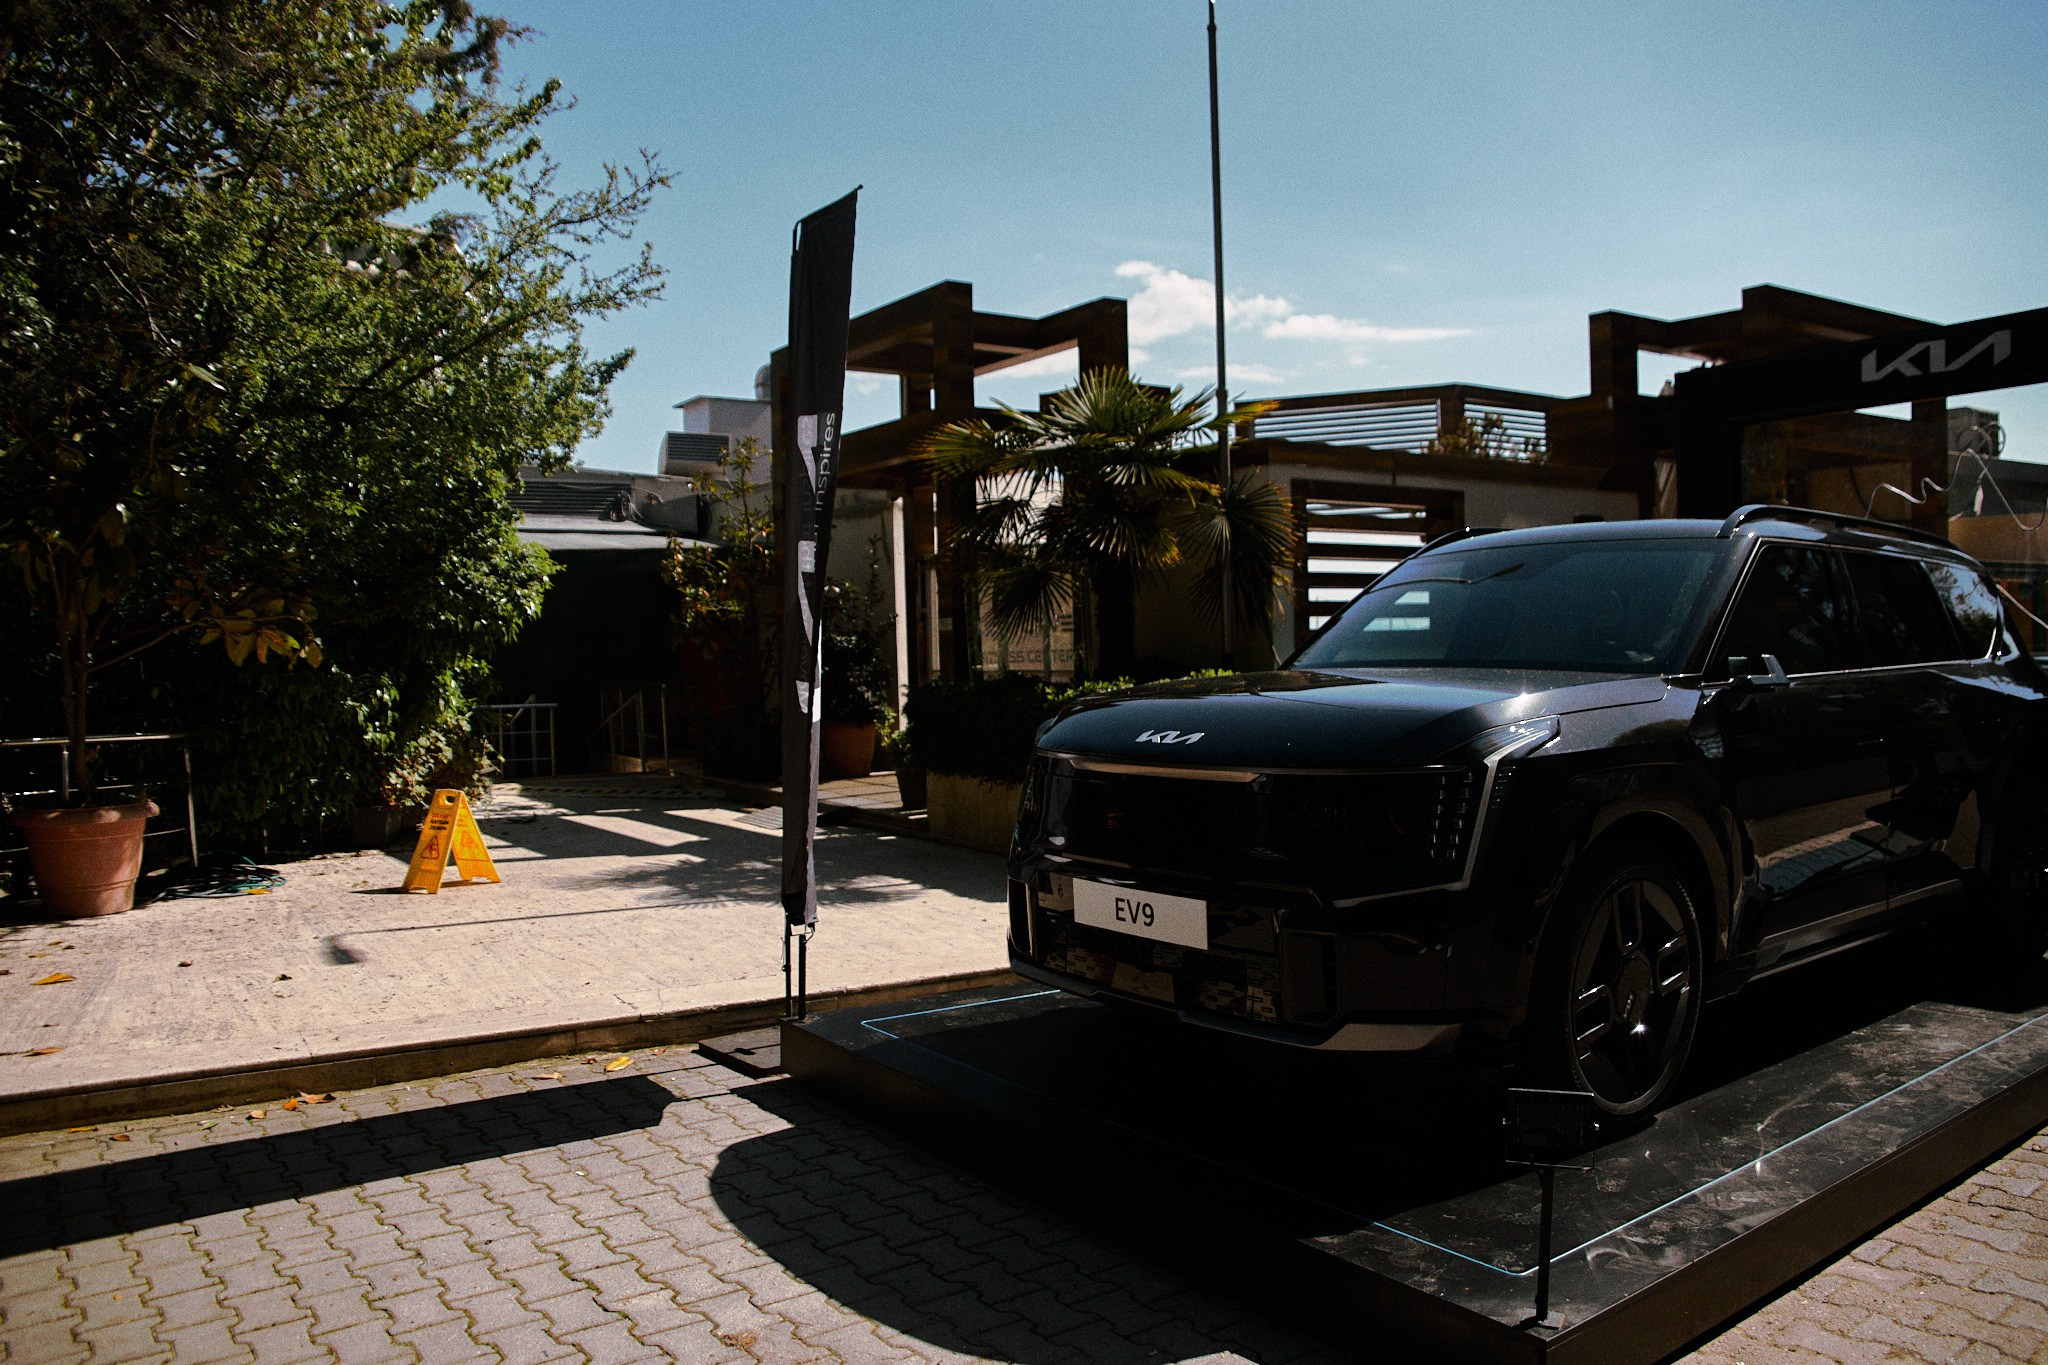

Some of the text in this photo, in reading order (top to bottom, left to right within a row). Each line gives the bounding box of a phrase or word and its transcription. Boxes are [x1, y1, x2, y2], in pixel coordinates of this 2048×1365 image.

[1860, 328, 2012, 383] KIA
[1027, 648, 1074, 663] CETER
[1135, 729, 1205, 745] KIA
[1115, 897, 1155, 927] EV9
